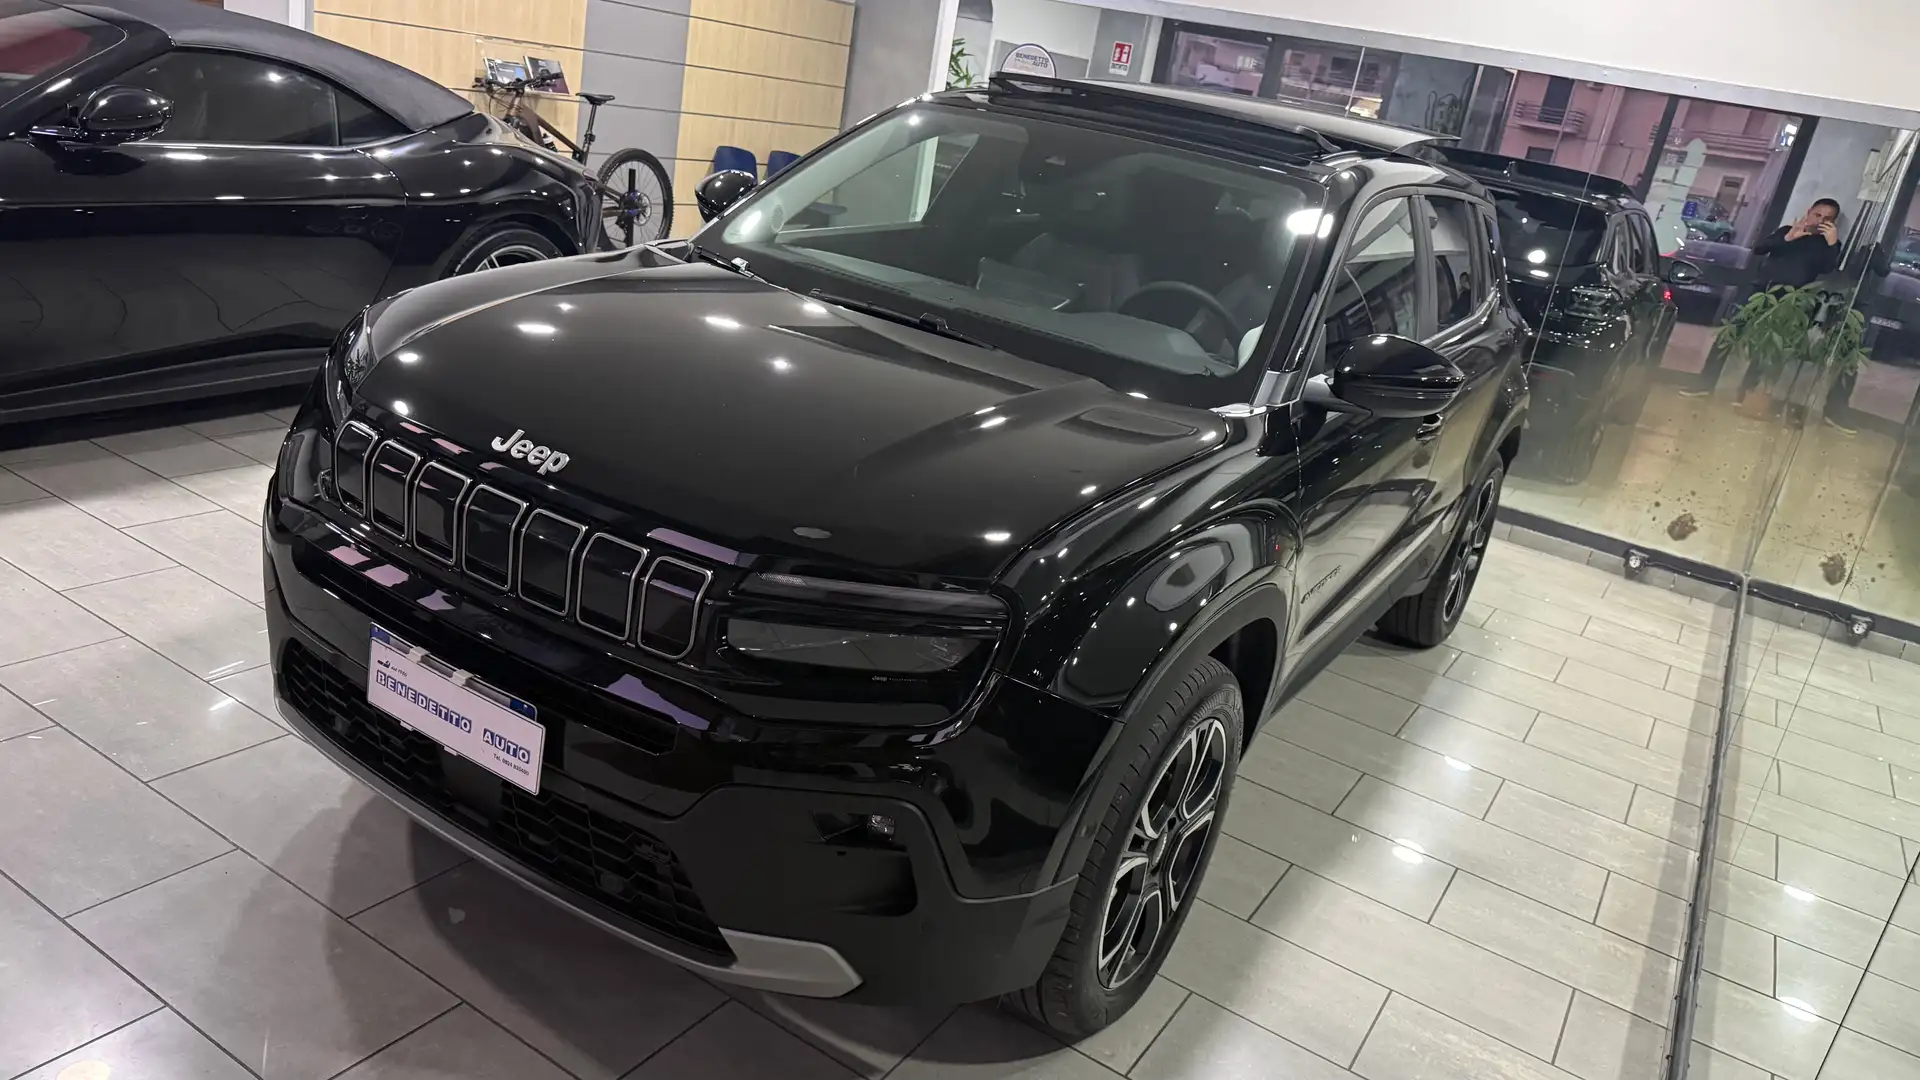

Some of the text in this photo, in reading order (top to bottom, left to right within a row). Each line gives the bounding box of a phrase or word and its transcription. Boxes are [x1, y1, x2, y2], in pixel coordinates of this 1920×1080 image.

[491, 428, 571, 476] Jeep
[376, 670, 530, 765] BENEDETTO AUTO
